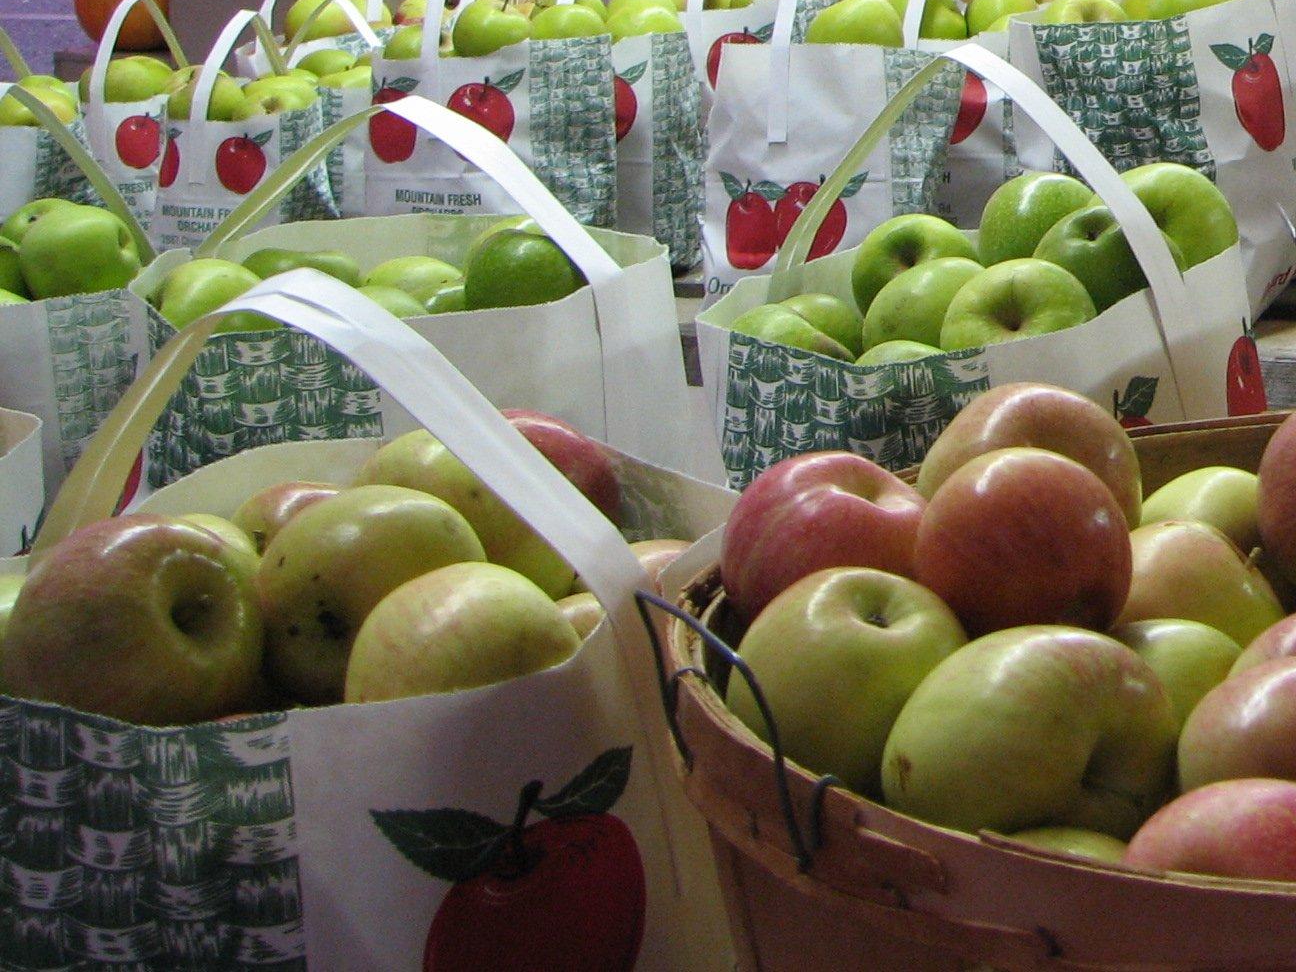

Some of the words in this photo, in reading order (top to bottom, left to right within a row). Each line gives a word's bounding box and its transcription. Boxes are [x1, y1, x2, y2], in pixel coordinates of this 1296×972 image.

[395, 189, 444, 205] MOUNTAIN
[448, 193, 482, 206] FRESH
[162, 204, 214, 218] MOUNTAIN
[177, 220, 217, 233] ORCHA
